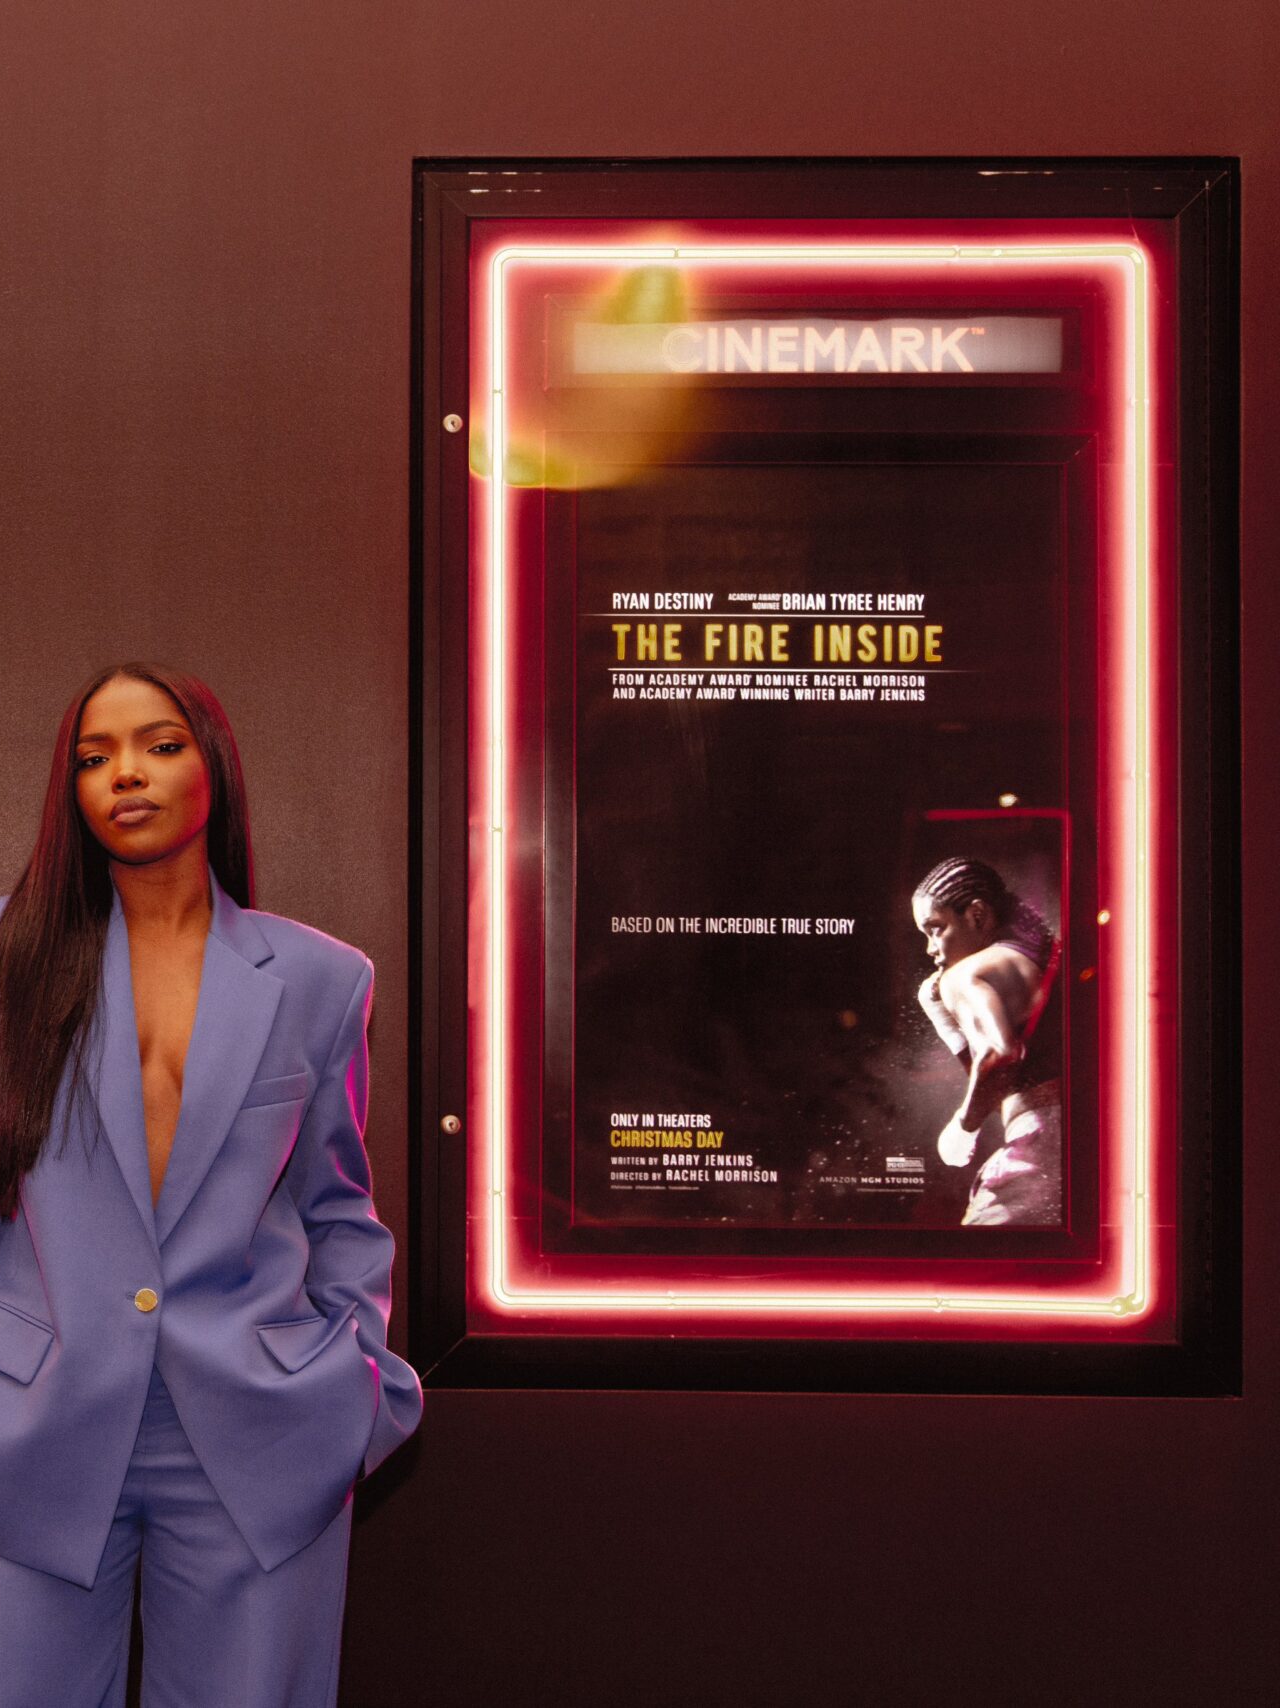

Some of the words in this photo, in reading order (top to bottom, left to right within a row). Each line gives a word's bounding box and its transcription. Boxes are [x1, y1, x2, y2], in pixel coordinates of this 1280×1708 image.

[612, 593, 649, 610] RYAN
[654, 593, 714, 610] DESTINY
[728, 593, 757, 601] ACADEMY
[782, 593, 826, 611] BRIAN
[830, 593, 873, 611] TYREE
[877, 593, 925, 611] HENRY
[752, 602, 780, 610] NOMINEE
[612, 624, 682, 662] THE
[705, 624, 789, 662] FIRE
[814, 624, 943, 662] INSIDE
[612, 673, 644, 686] FROM
[649, 673, 704, 686] ACADEMY
[756, 674, 808, 687] NOMINEE
[814, 674, 857, 687] RACHEL
[863, 675, 925, 687] MORRISON
[612, 687, 636, 700] AND
[639, 687, 692, 700] ACADEMY
[740, 688, 789, 700] WINNING
[794, 688, 835, 701] WRITER
[840, 689, 875, 701] BARRY
[880, 689, 925, 701] JENKINS
[611, 917, 652, 934] BASED
[656, 917, 674, 934] ON
[679, 917, 701, 934] THE
[705, 917, 777, 934] INCREDIBLE
[781, 917, 811, 934] TRUE
[815, 917, 855, 934] STORY
[610, 1113, 639, 1127] ONLY
[642, 1113, 654, 1127] IN
[657, 1113, 711, 1128] THEATERS
[610, 1130, 692, 1148] CHRISTMAS
[696, 1130, 724, 1148] DAY
[610, 1156, 646, 1165] WRITTEN
[648, 1157, 658, 1166] BY
[662, 1154, 699, 1166] BARRY
[705, 1154, 753, 1167] JENKINS
[610, 1172, 649, 1181] DIRECTED
[651, 1172, 662, 1181] BY
[666, 1169, 710, 1182] RACHEL
[715, 1170, 778, 1183] MORRISON
[819, 1176, 857, 1184] AMAZON
[861, 1176, 882, 1184] MGM
[885, 1176, 925, 1184] STUDIOS
